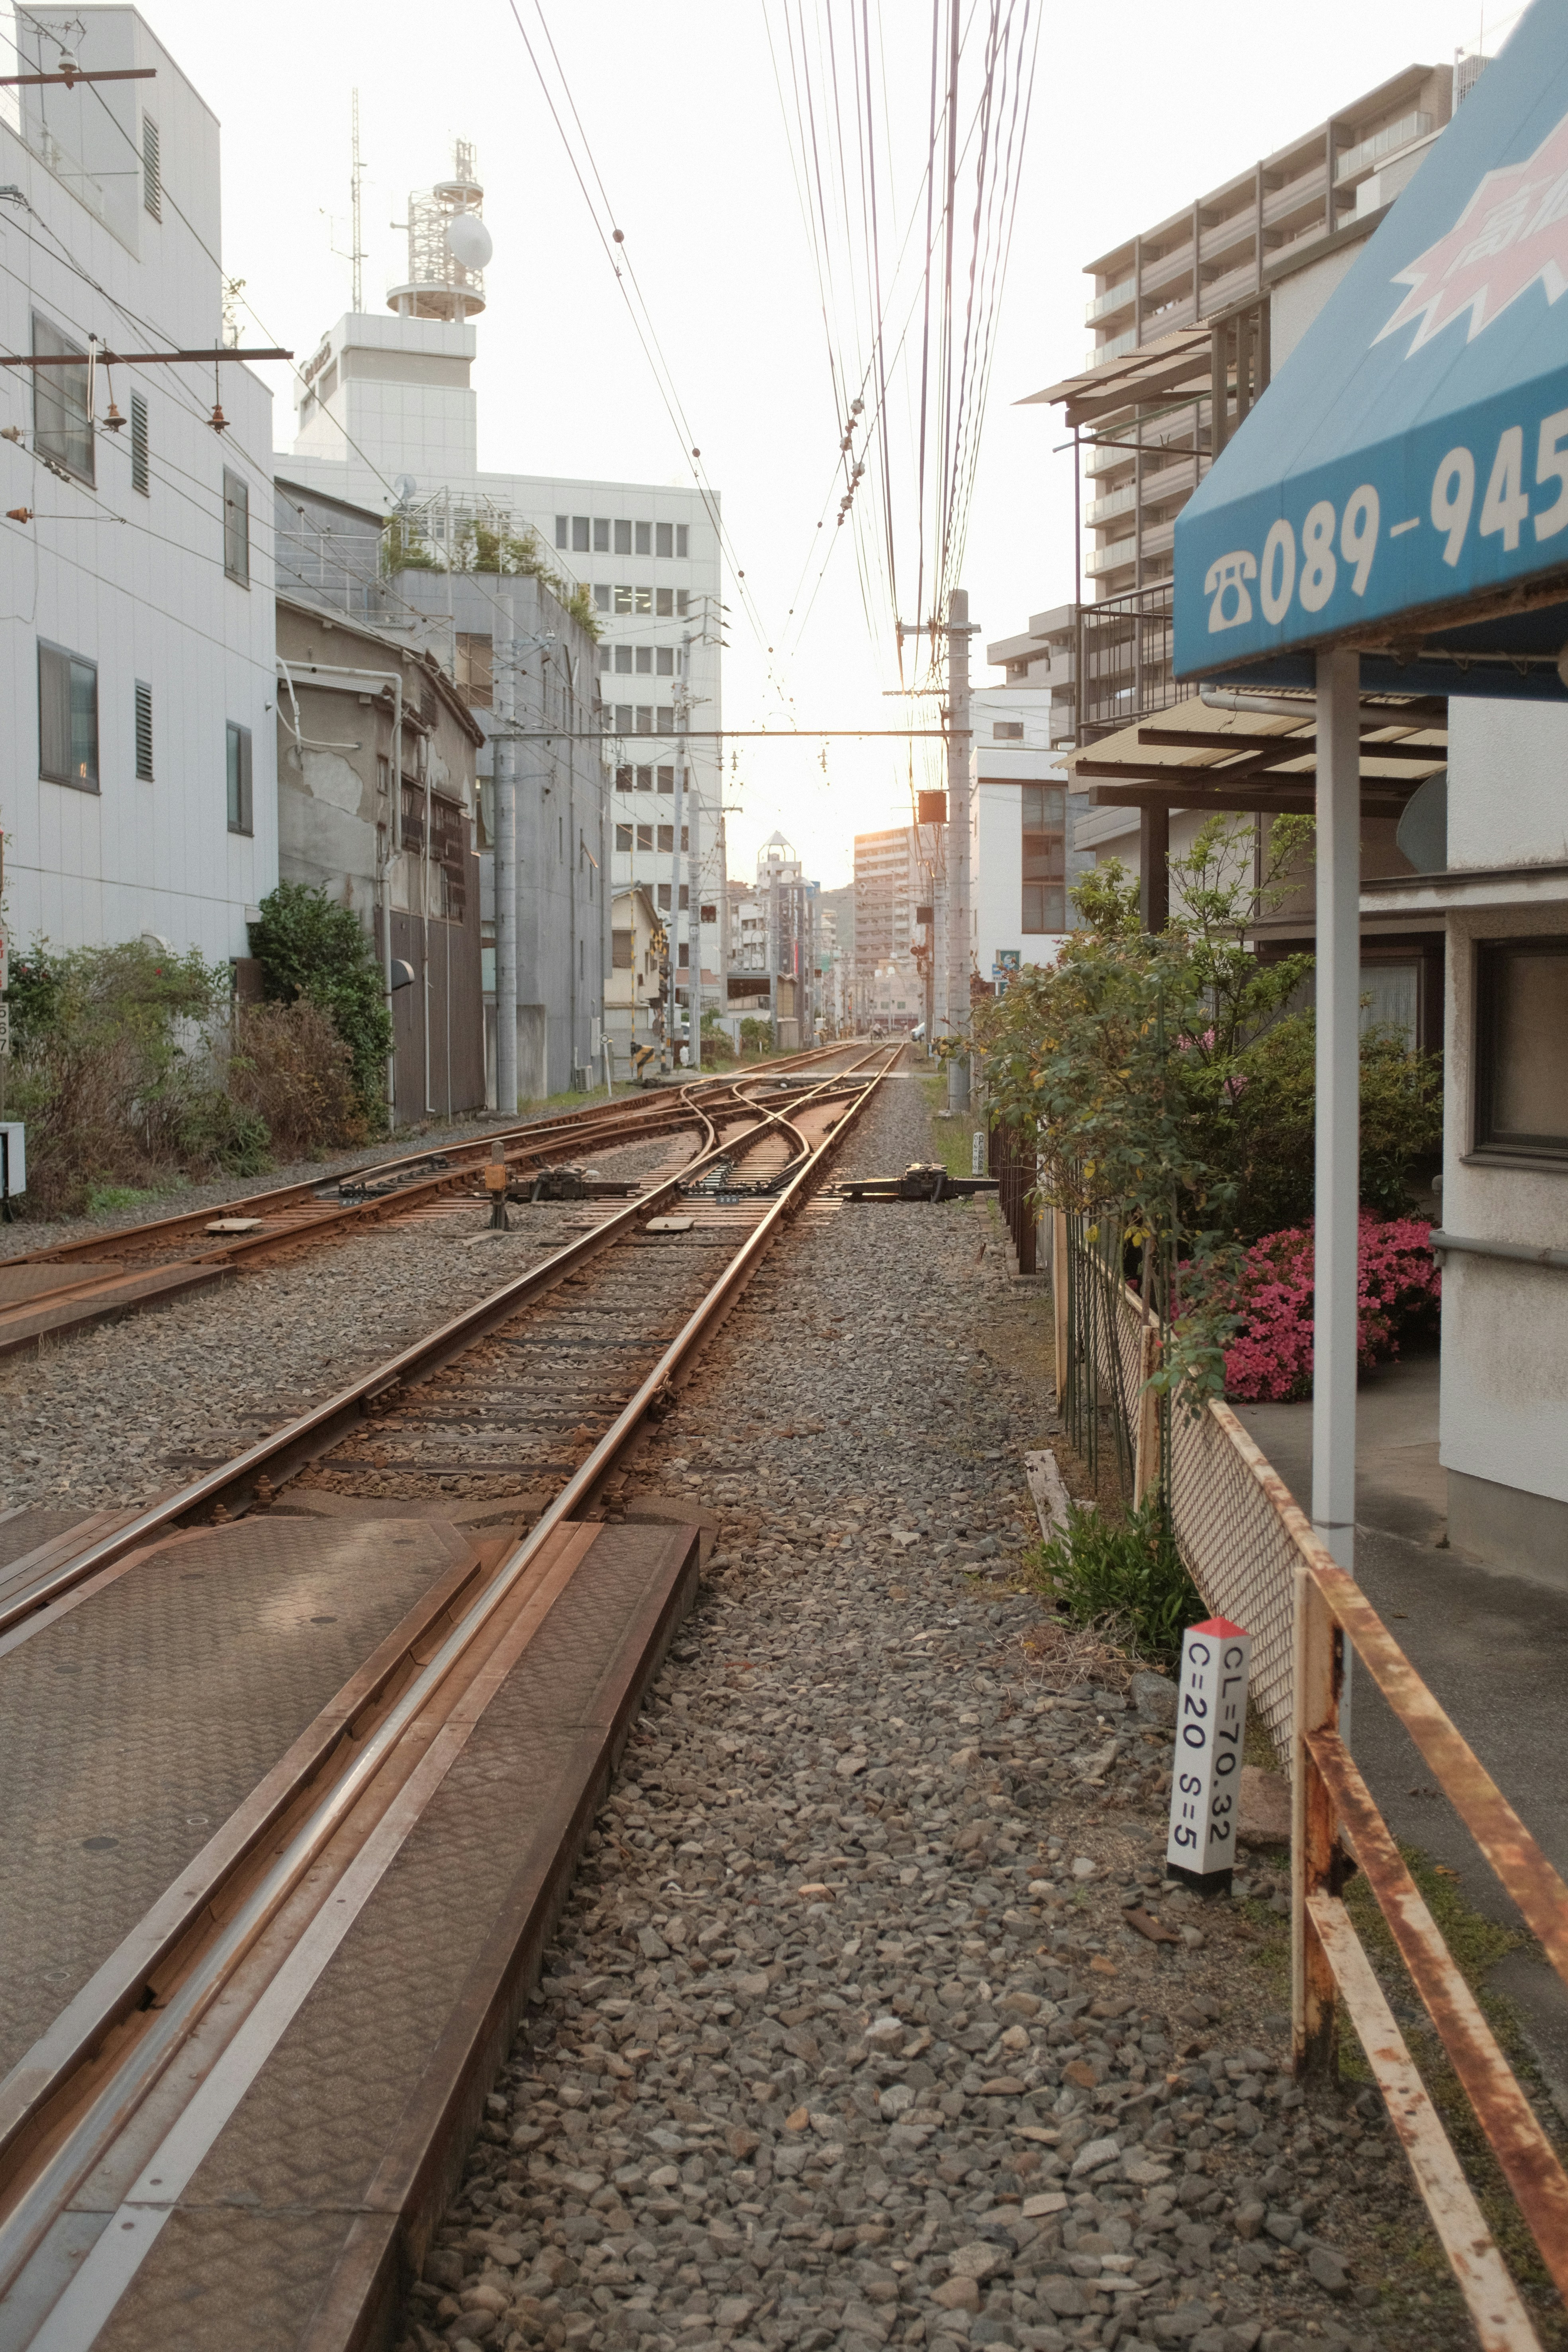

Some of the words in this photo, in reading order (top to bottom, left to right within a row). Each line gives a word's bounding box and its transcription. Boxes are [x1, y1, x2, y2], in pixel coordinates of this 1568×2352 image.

[1183, 1642, 1210, 1749] C=20
[1209, 1646, 1243, 1844] CL=70.32
[1174, 1773, 1202, 1850] S=5
